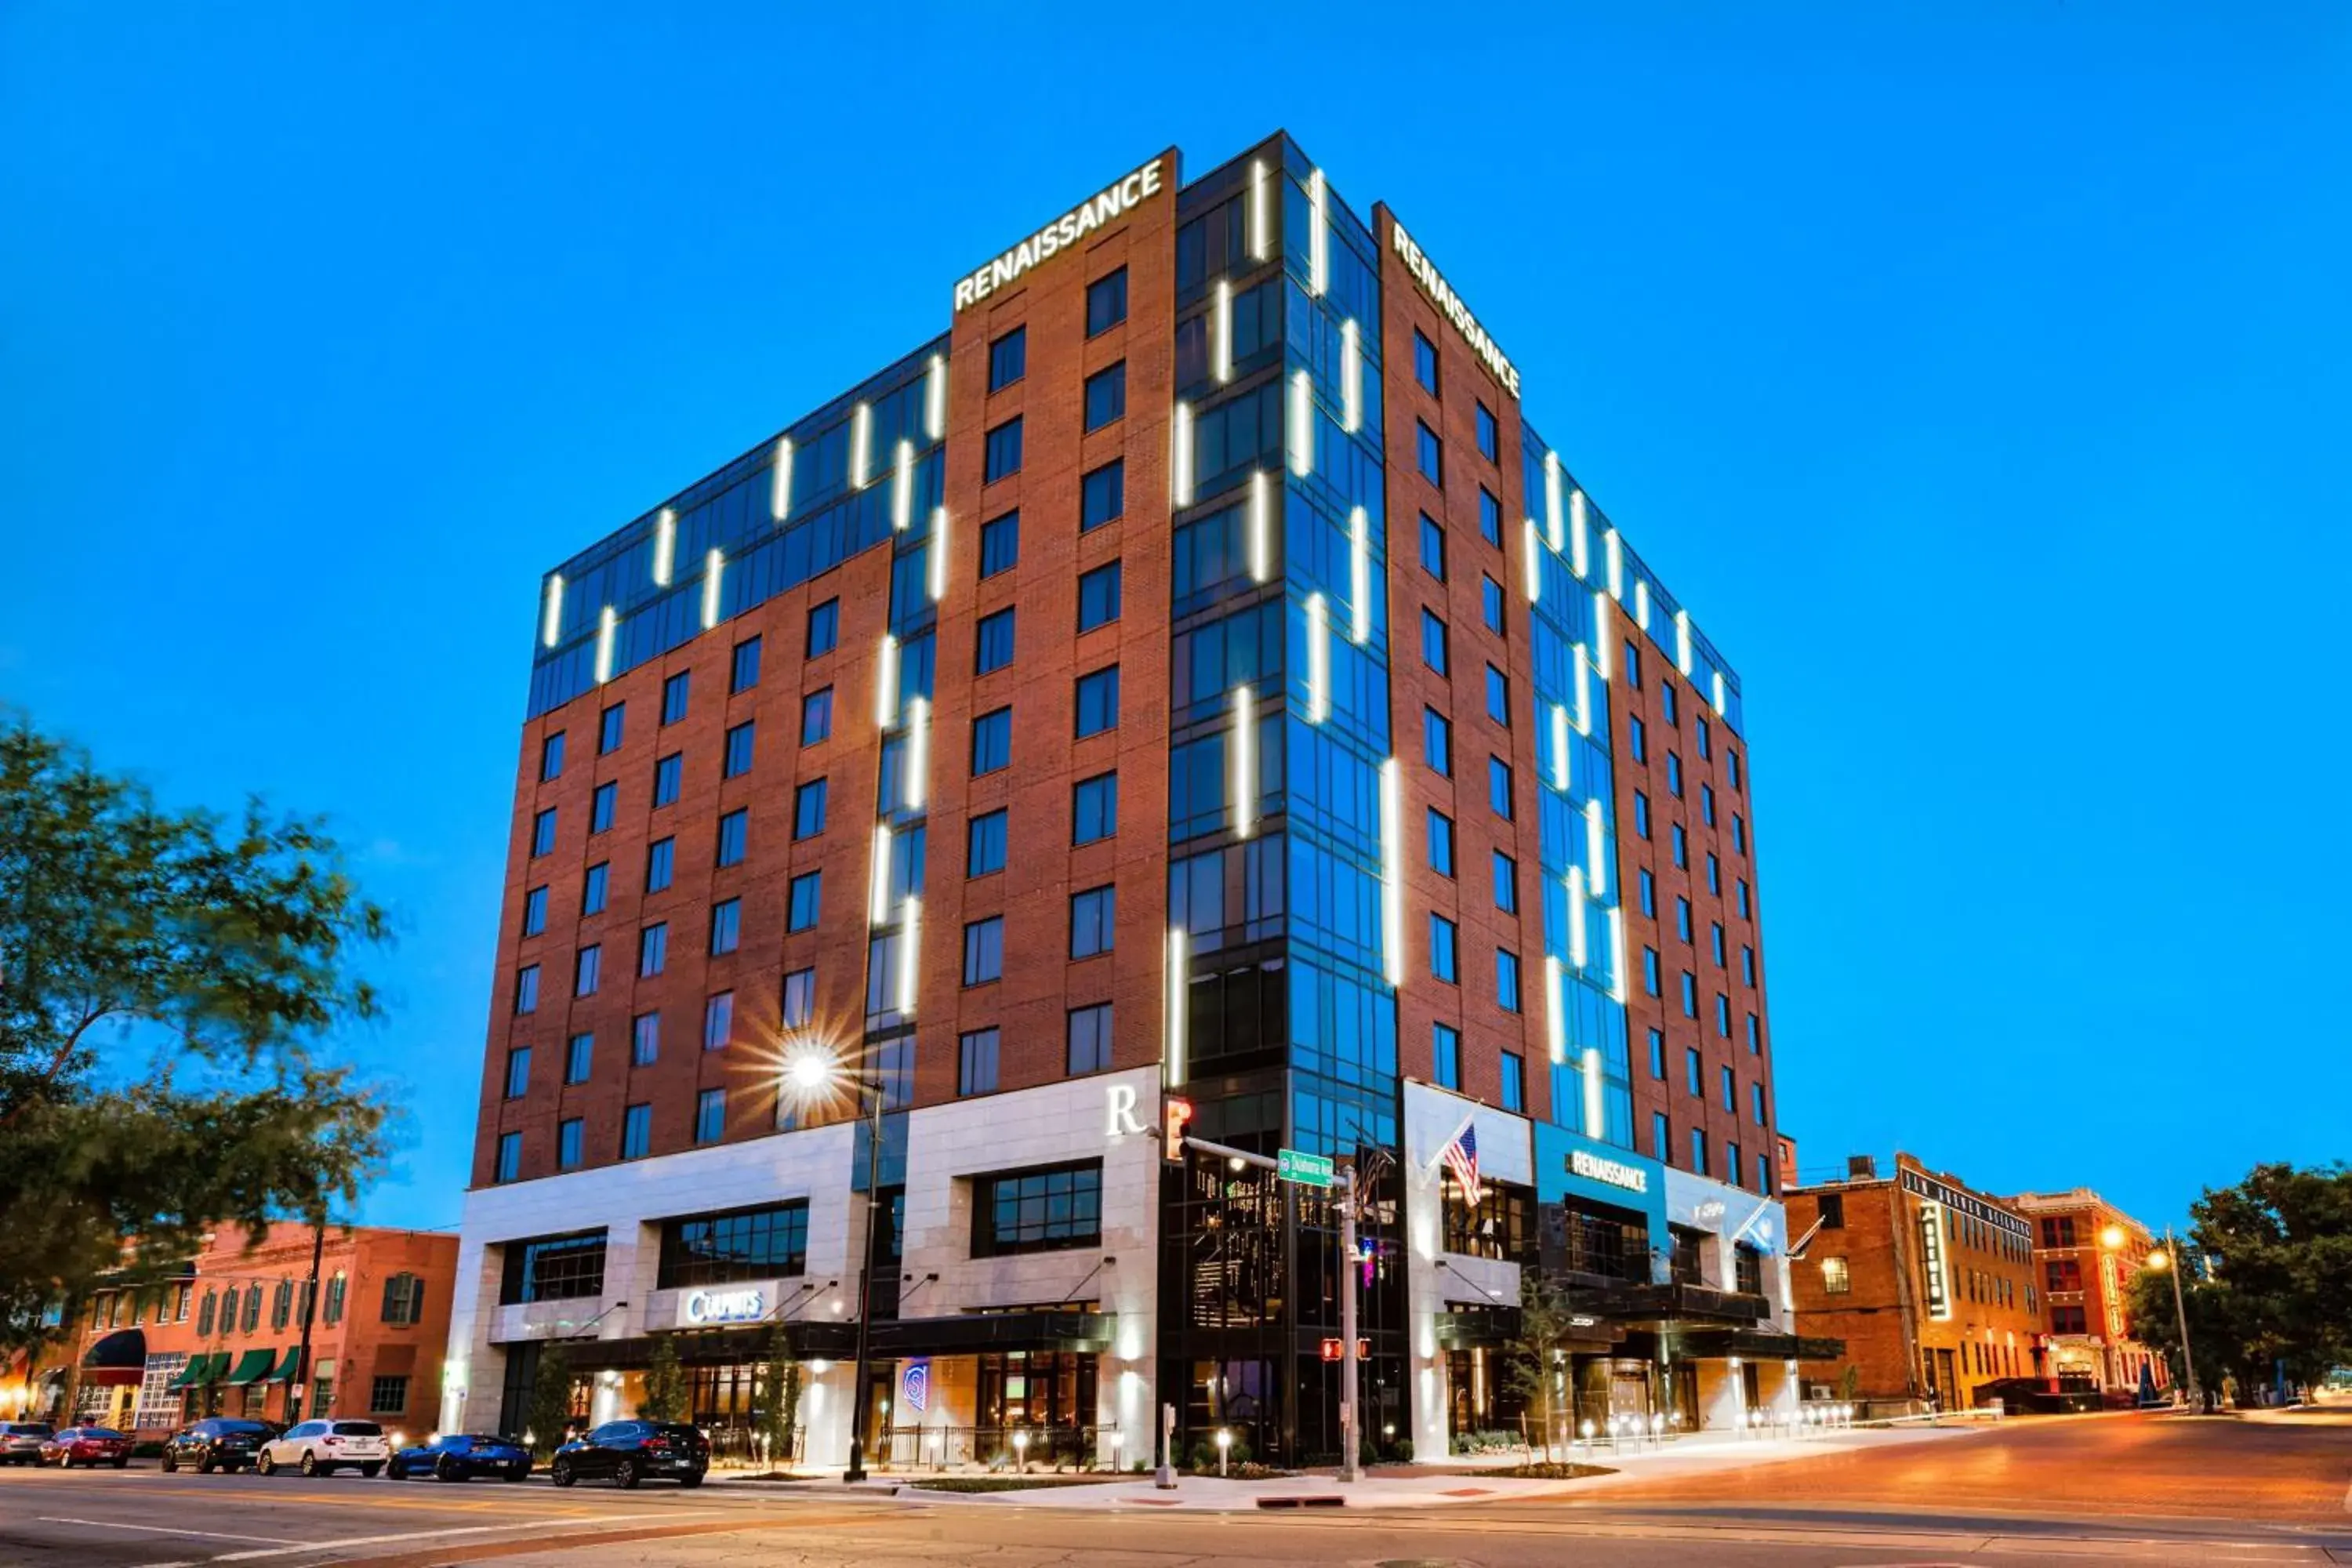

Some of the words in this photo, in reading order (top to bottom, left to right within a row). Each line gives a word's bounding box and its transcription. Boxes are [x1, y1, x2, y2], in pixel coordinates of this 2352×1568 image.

[954, 158, 1163, 311] RENAISSANCE
[1393, 220, 1520, 401] RENAISSANCE
[1105, 1085, 1148, 1136] R
[1572, 1149, 1646, 1193] RENAISSANCE
